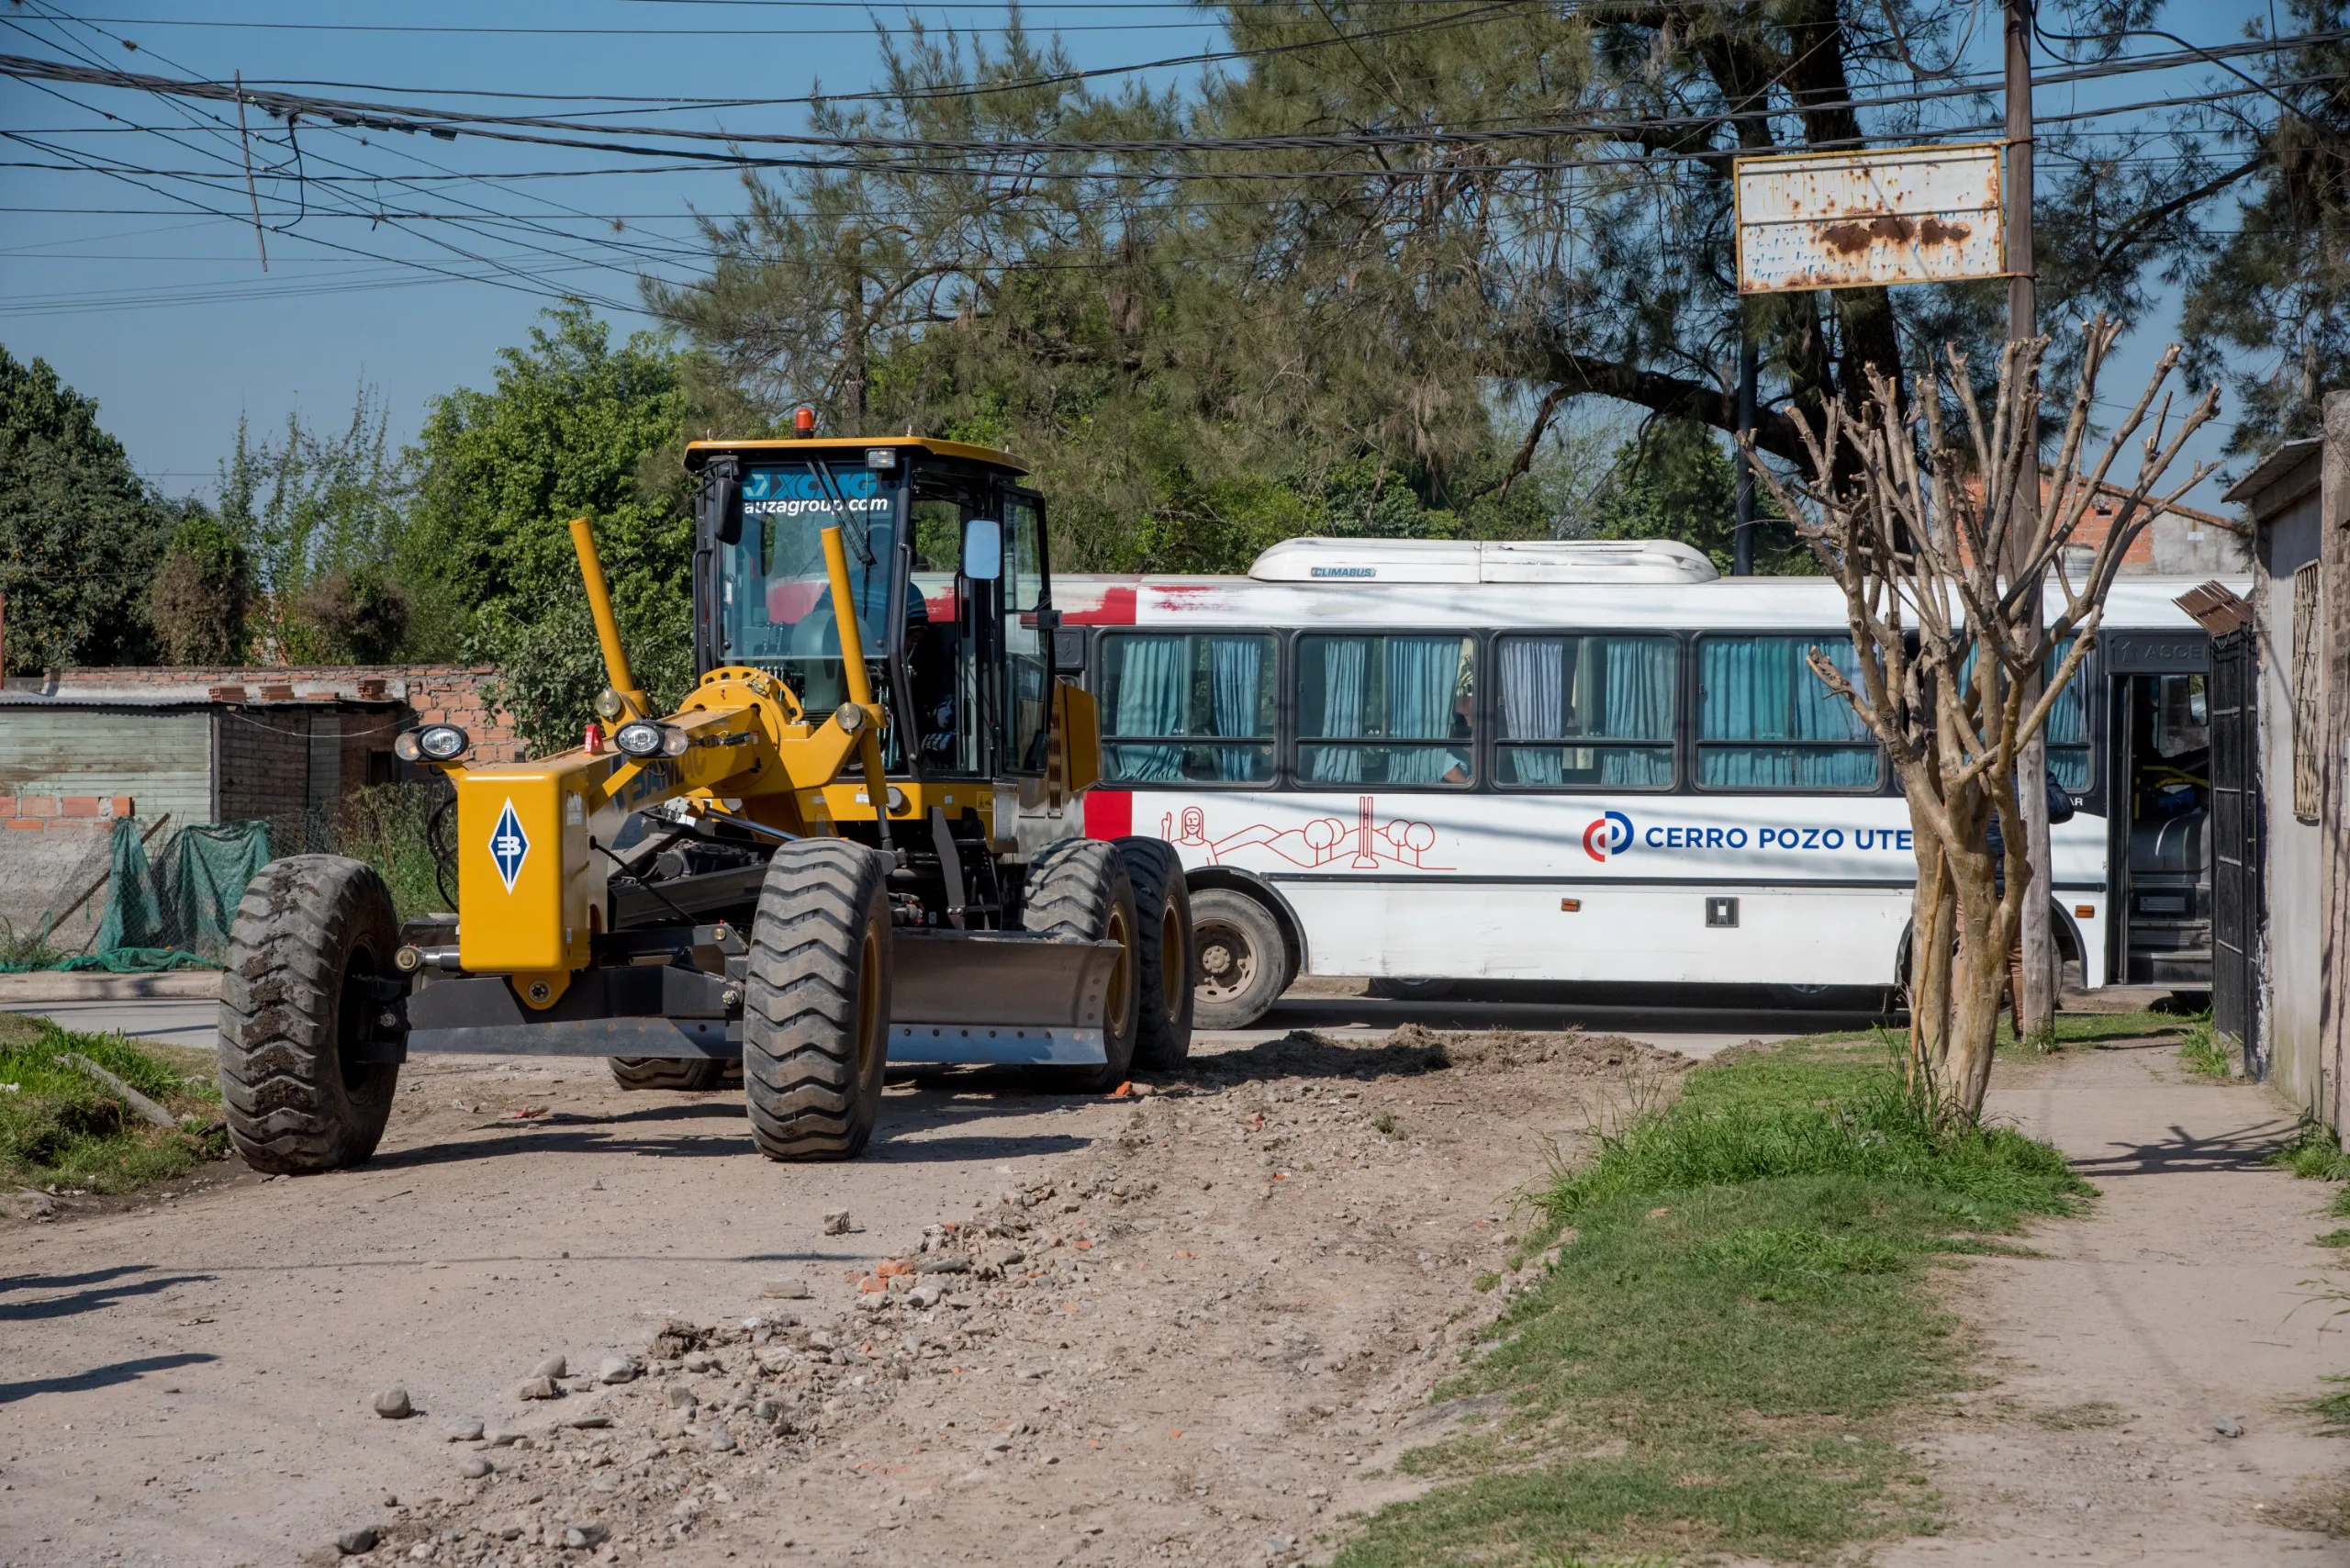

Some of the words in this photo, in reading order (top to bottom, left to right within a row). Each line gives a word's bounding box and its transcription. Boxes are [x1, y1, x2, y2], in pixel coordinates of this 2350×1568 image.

[769, 473, 878, 499] XCMG
[1314, 567, 1371, 577] CLIMABUS
[1645, 826, 1748, 849] CERRO
[1759, 828, 1844, 850] POZO
[1855, 829, 1913, 850] UTE
